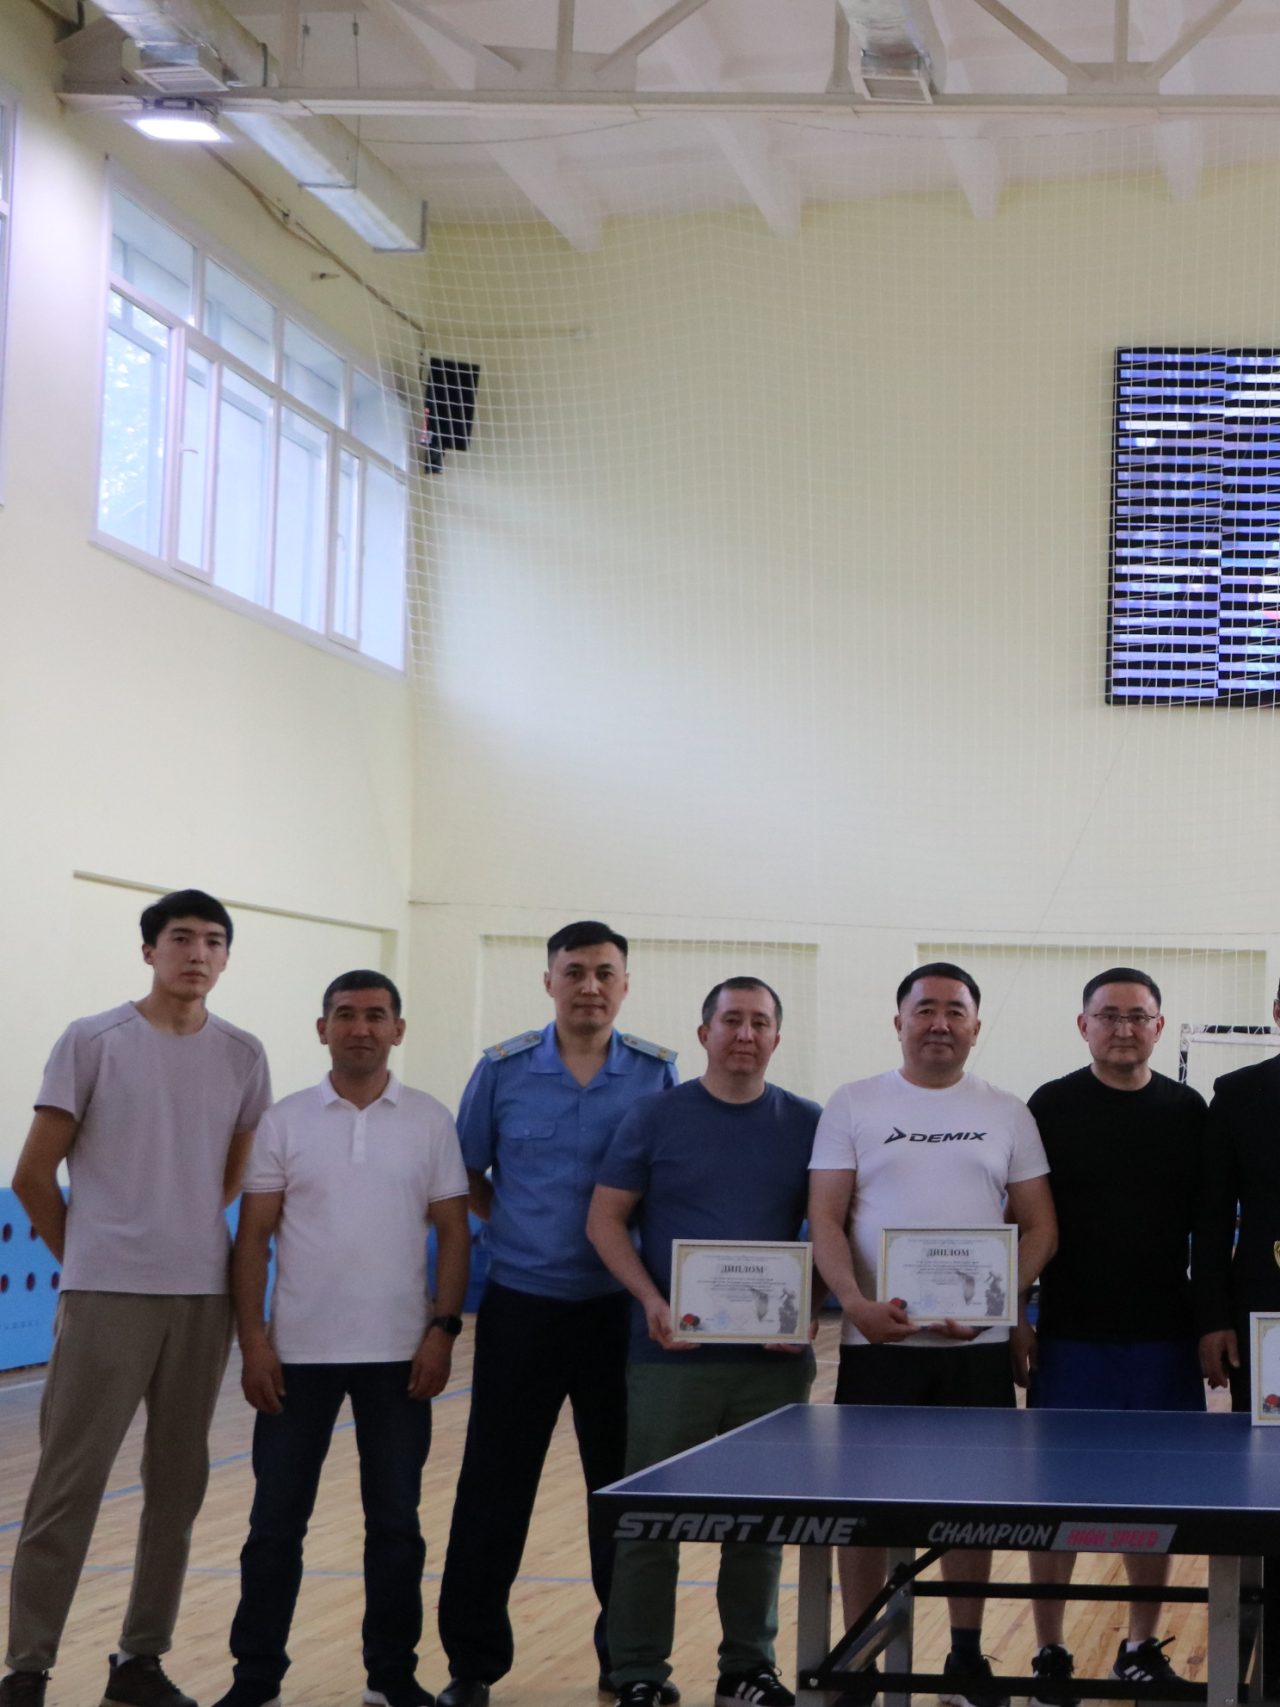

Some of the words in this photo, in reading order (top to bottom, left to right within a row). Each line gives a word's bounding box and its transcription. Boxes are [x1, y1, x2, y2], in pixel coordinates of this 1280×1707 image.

[909, 1132, 988, 1143] DEMIX
[613, 1511, 764, 1541] START
[766, 1515, 860, 1544] LINE
[927, 1521, 1053, 1546] CHAMPION
